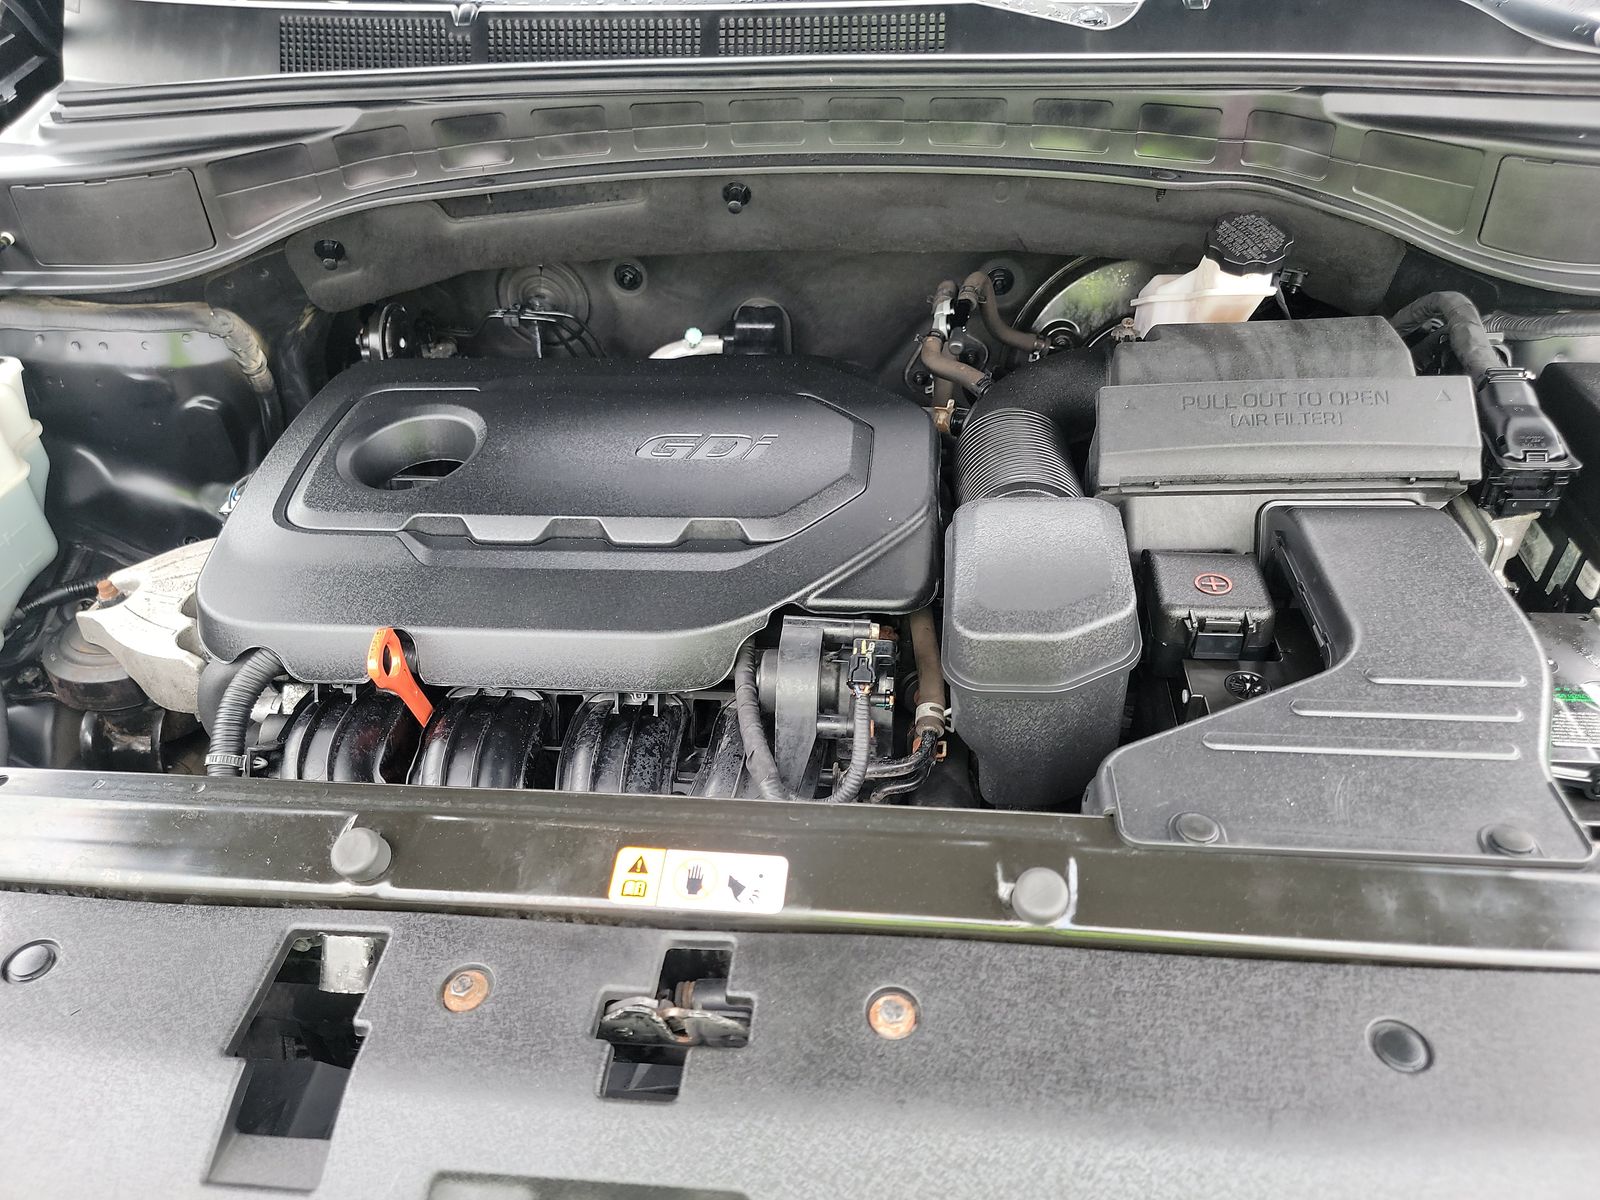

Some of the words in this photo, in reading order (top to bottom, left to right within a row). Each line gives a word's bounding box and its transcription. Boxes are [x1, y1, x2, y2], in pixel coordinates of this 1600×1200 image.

[1182, 393, 1238, 410] PULL
[1242, 392, 1287, 408] OUT
[1293, 391, 1322, 407] TO
[1328, 389, 1390, 406] OPEN
[635, 433, 779, 460] GDi
